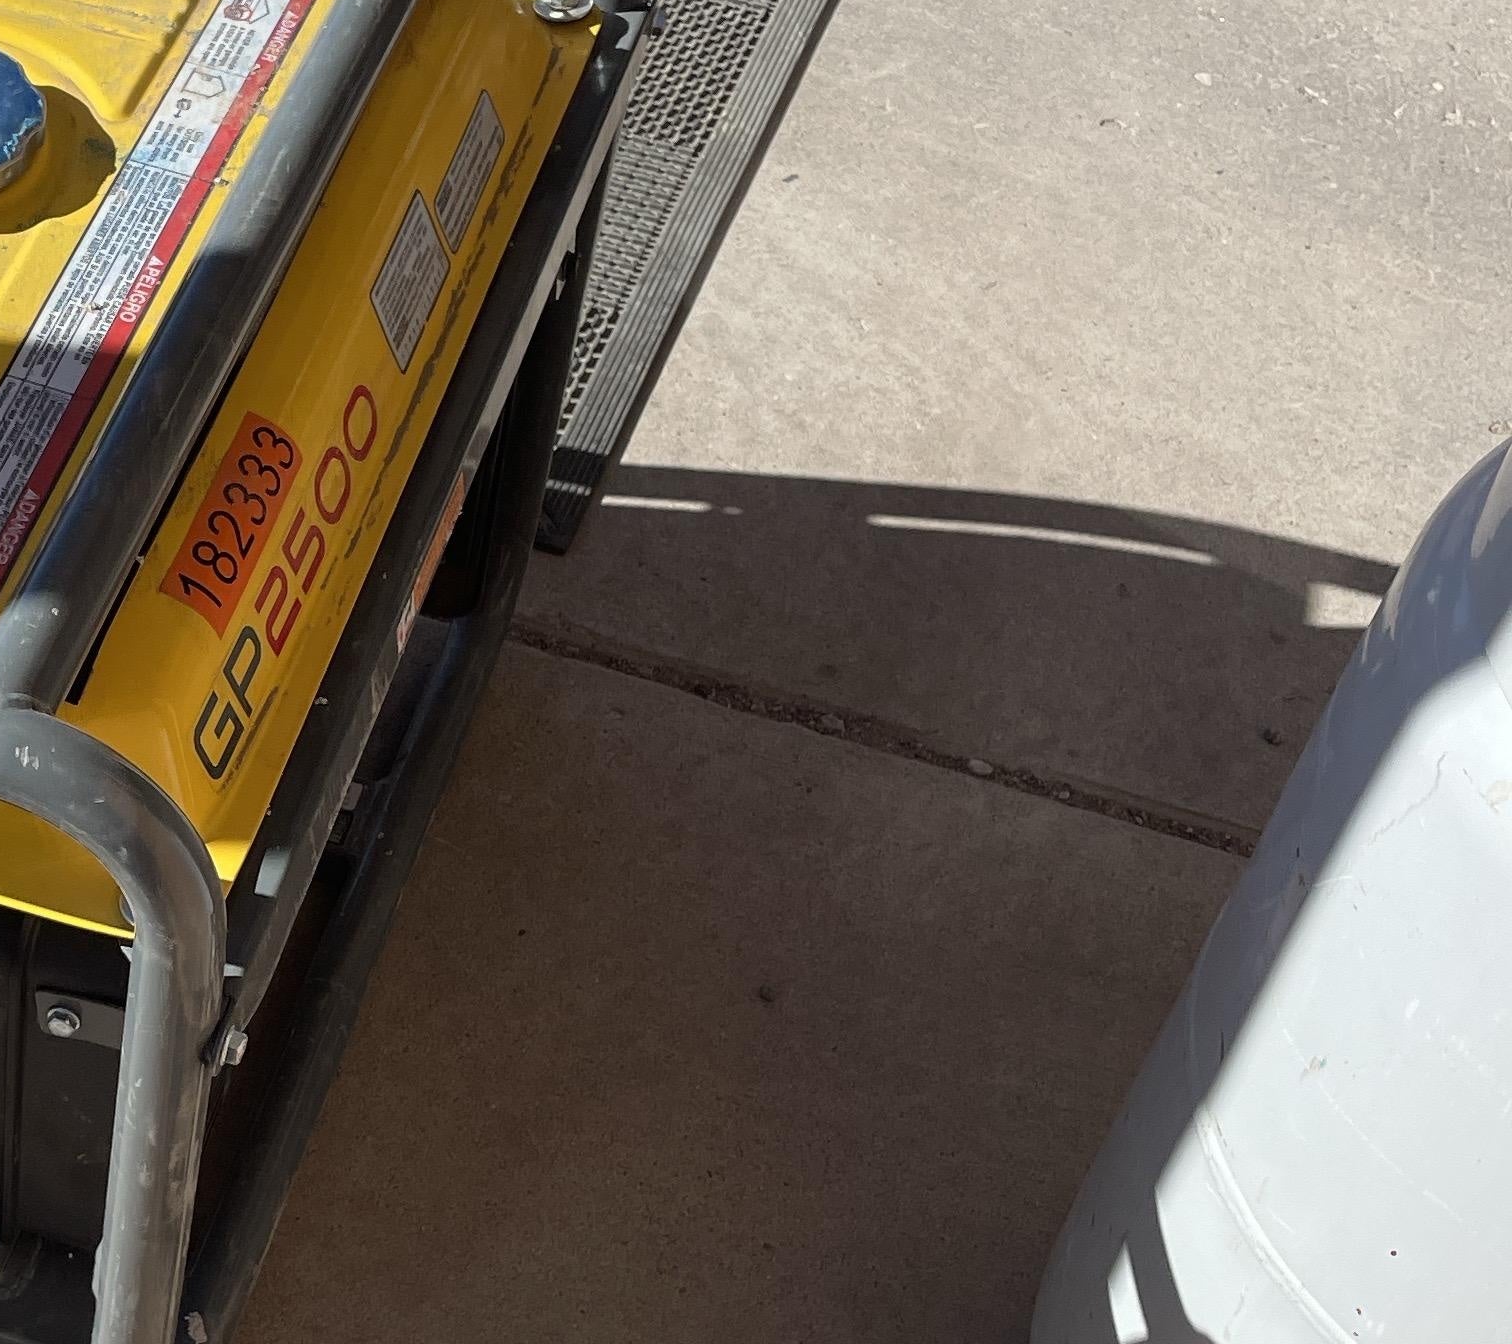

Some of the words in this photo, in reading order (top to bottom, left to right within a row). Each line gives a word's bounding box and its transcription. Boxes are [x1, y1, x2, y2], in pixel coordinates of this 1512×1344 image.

[261, 19, 296, 62] DANGER
[117, 266, 161, 323] PELIGRO
[179, 426, 294, 608] 182333
